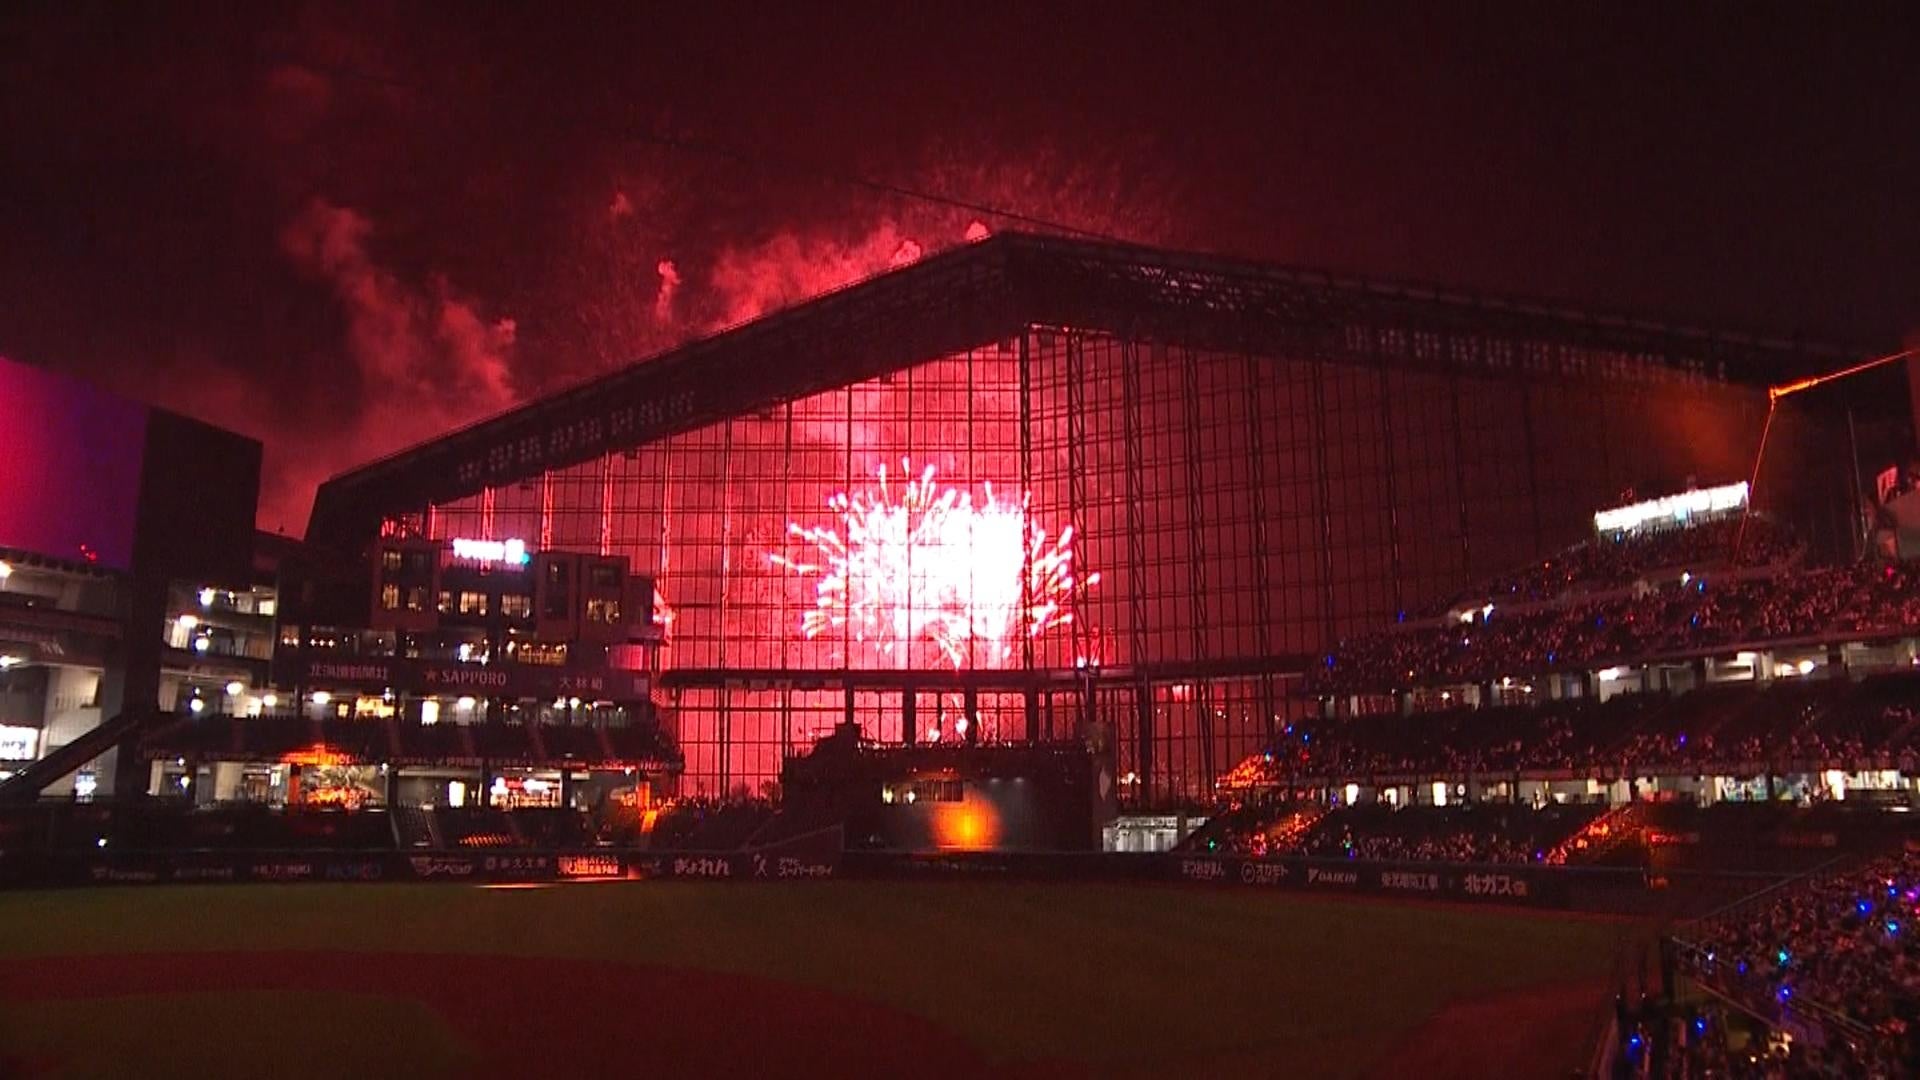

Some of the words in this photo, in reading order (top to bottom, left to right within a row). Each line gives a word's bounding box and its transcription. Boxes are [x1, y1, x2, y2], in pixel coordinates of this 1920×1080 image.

[441, 670, 507, 686] SAPPORO
[673, 856, 731, 876] ぎょれん
[1318, 870, 1358, 884] DAIKIN
[1464, 872, 1513, 896] 北ガス
